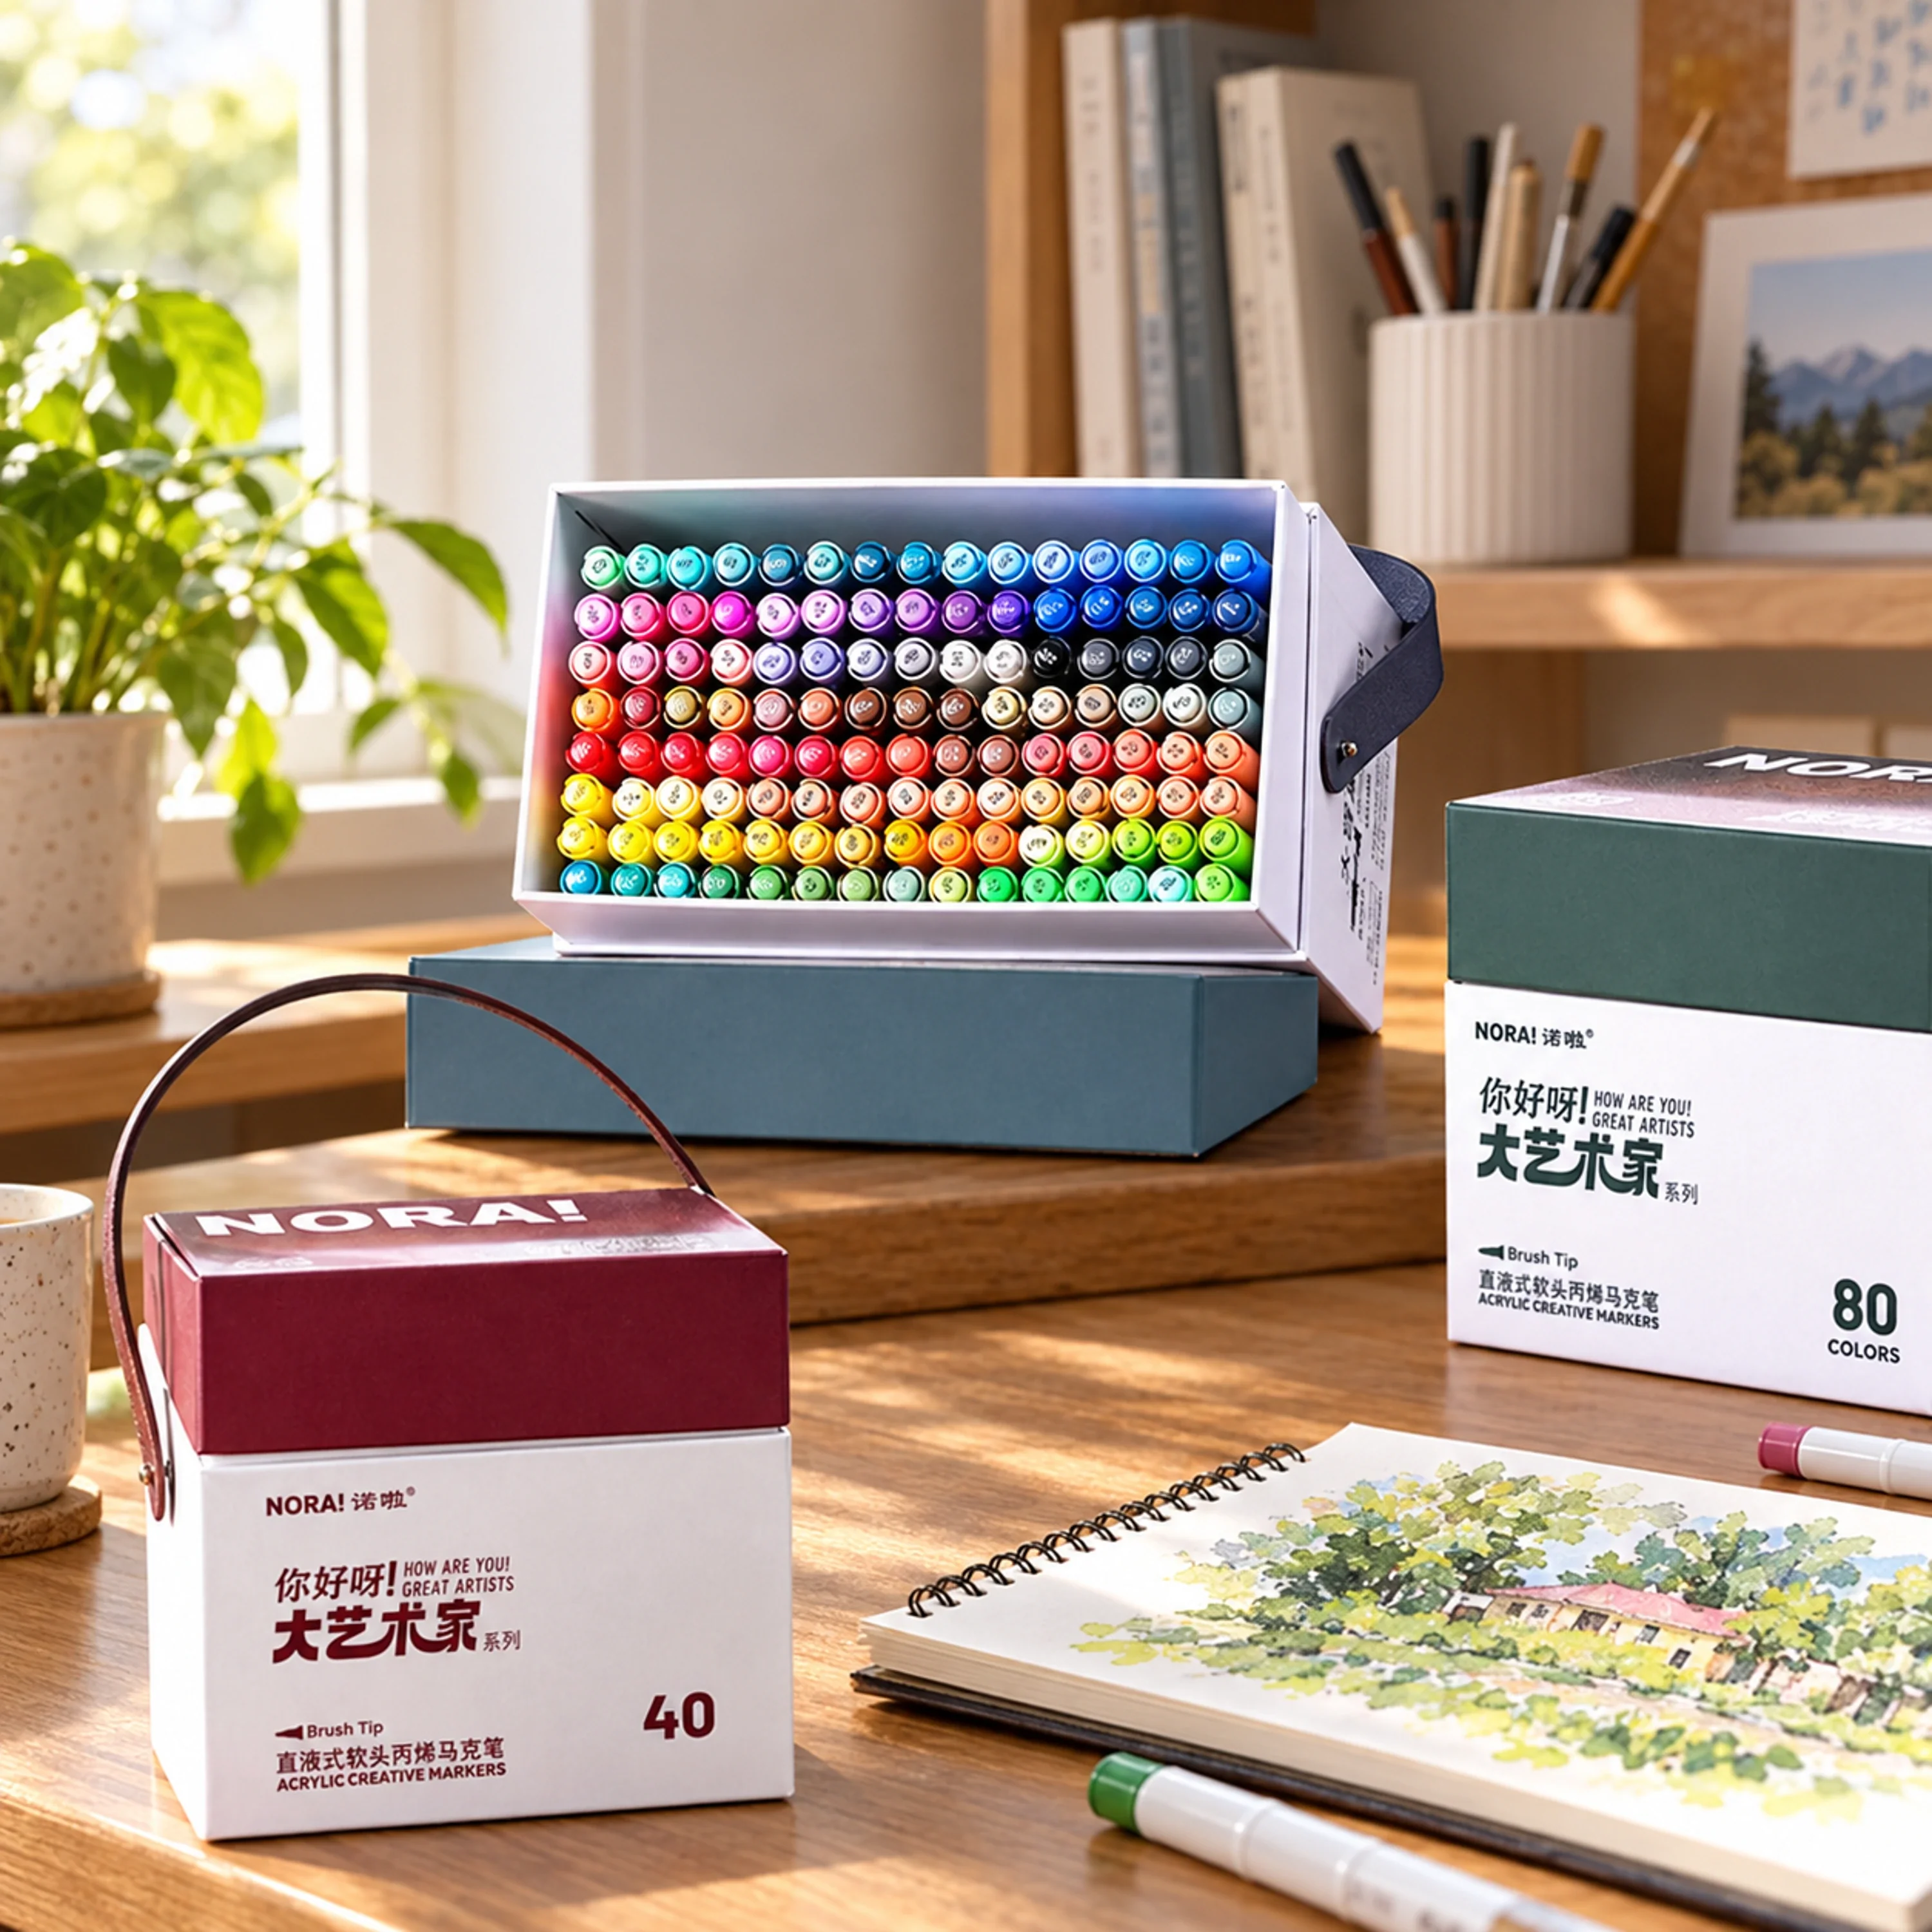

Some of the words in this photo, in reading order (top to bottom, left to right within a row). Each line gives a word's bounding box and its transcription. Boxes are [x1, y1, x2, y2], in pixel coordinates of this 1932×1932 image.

[1703, 752, 1932, 783] NOR
[1475, 1021, 1537, 1045] NORA!
[1479, 1075, 1589, 1125] 你好呀!
[1594, 1090, 1625, 1109] HOW
[1627, 1094, 1655, 1113] ARE
[1660, 1097, 1692, 1117] YOU!
[1592, 1110, 1635, 1132] GREAT
[1638, 1115, 1695, 1139] ARTISTS
[1477, 1122, 1664, 1199] 大艺术家
[1665, 1181, 1698, 1206] 系列
[195, 1199, 587, 1236] NORA!
[1508, 1245, 1550, 1265] Brush
[1553, 1251, 1579, 1272] Tip
[1479, 1269, 1660, 1313] 直液式软头丙烯马克笔
[1478, 1292, 1531, 1311] ACRYLIC
[1532, 1300, 1594, 1321] CREATIVE
[1596, 1308, 1660, 1330] MARKERS
[1832, 1278, 1898, 1336] 80
[1827, 1338, 1900, 1364] COLORS
[266, 1492, 345, 1517] NORA!
[274, 1559, 398, 1604] 你好呀!
[403, 1560, 437, 1578] HOW
[441, 1557, 470, 1575] ARE
[475, 1555, 510, 1573] YOU!
[401, 1578, 450, 1598] GREAT
[454, 1575, 515, 1595] ARTISTS
[271, 1598, 482, 1664] 大艺术家
[482, 1629, 521, 1653] 系列
[307, 1721, 354, 1739] Brush
[357, 1720, 384, 1738] Tip
[643, 1691, 715, 1740] 40
[276, 1736, 505, 1775] 直液式软头丙烯马克笔
[276, 1772, 345, 1792] ACRYLIC
[347, 1768, 426, 1788] CREATIVE
[428, 1761, 507, 1781] MARKERS
